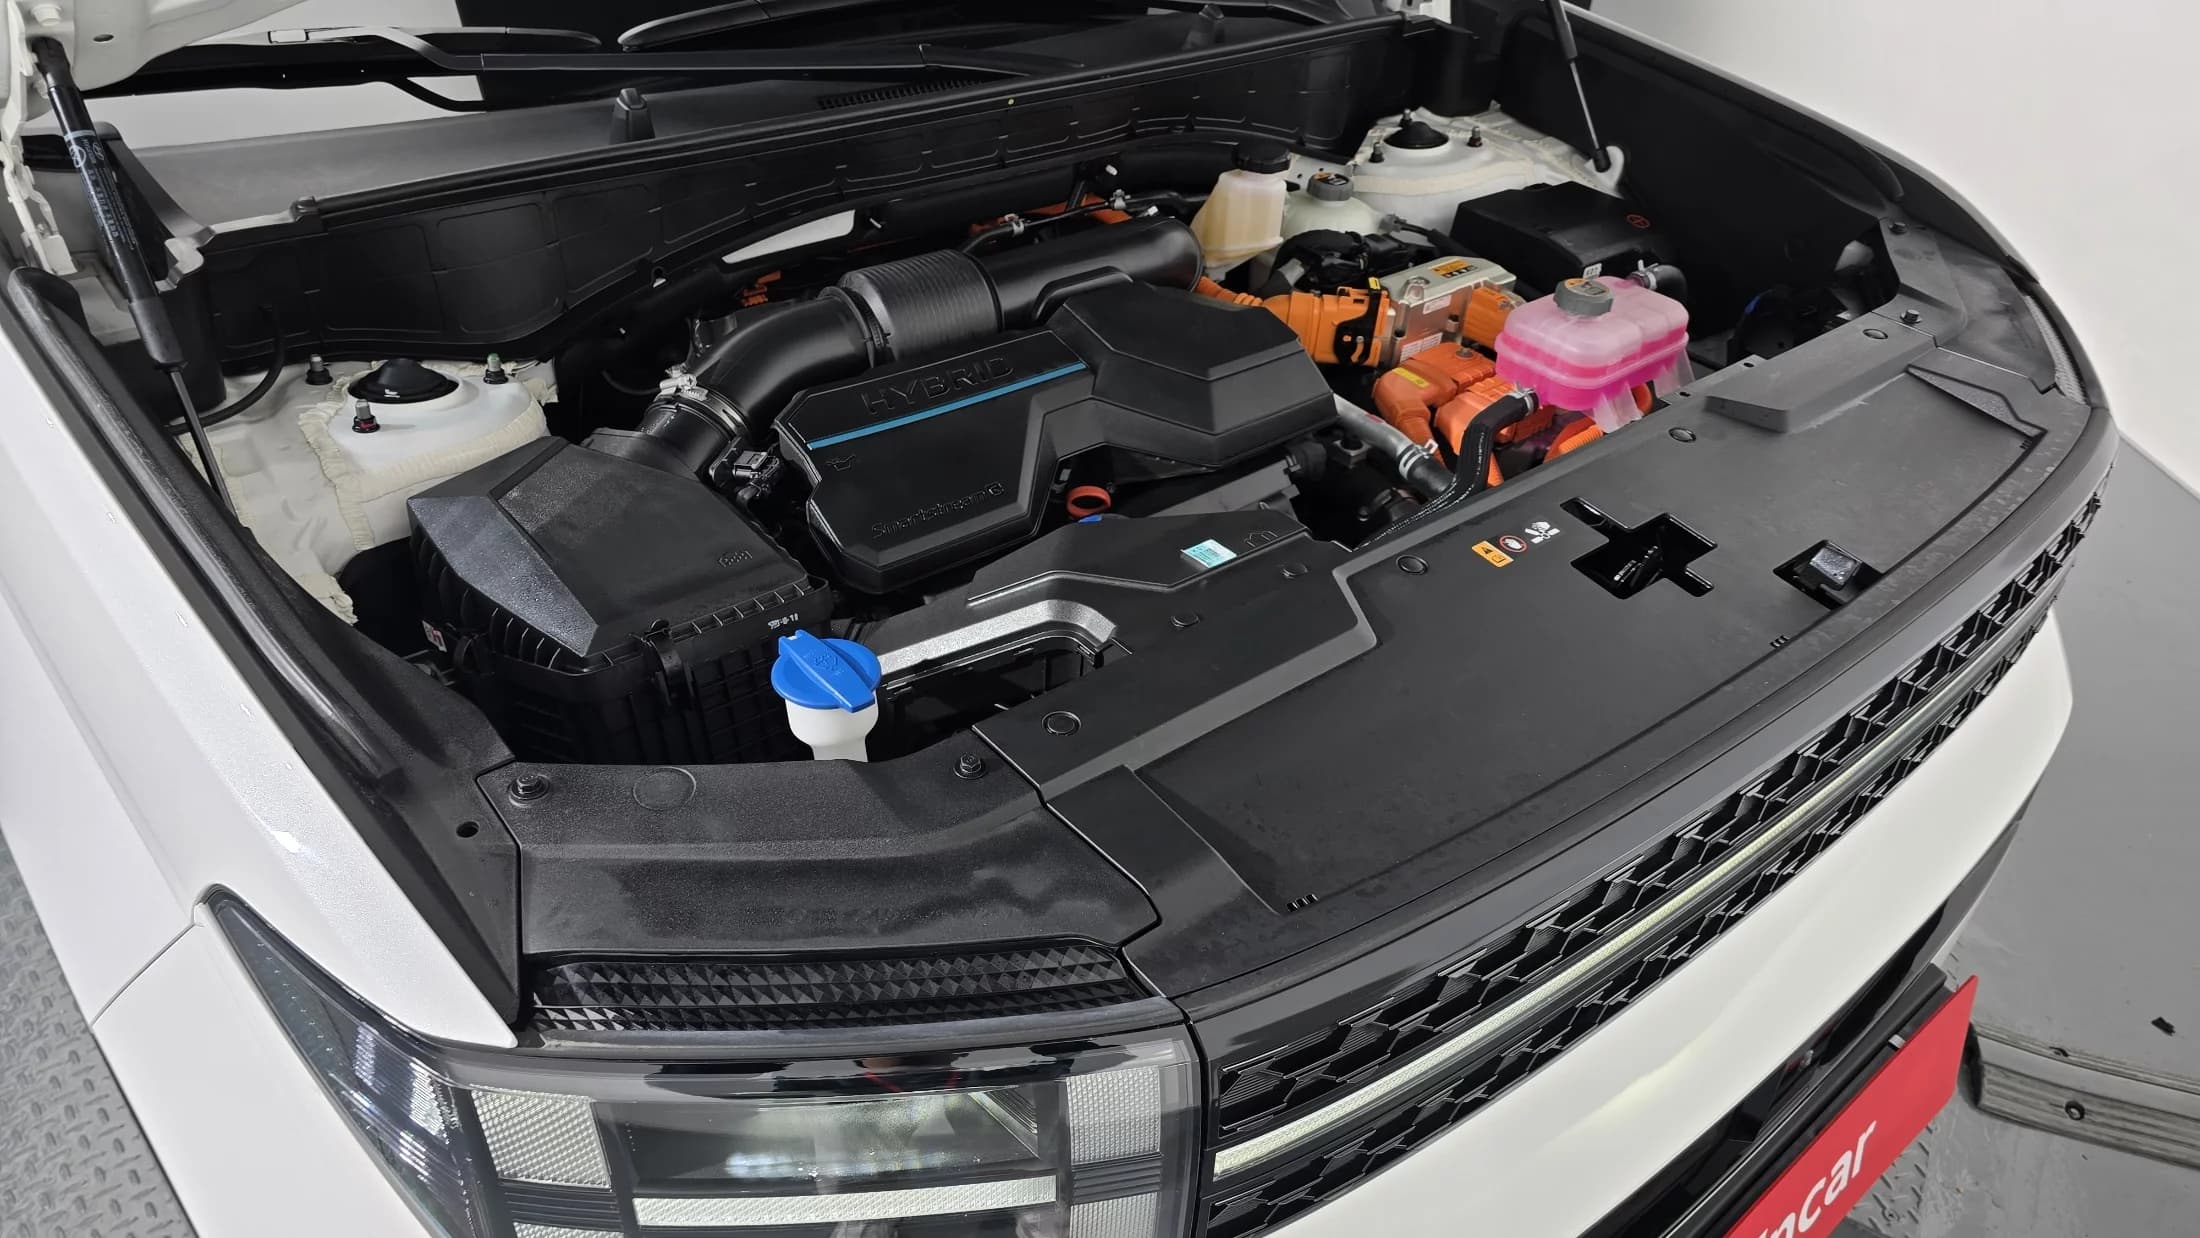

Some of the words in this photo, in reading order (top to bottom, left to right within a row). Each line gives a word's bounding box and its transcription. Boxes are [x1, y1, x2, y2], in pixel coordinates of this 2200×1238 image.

[860, 357, 1014, 415] HYBRID
[871, 490, 987, 539] Smartstream
[1759, 1120, 1877, 1238] ncar
